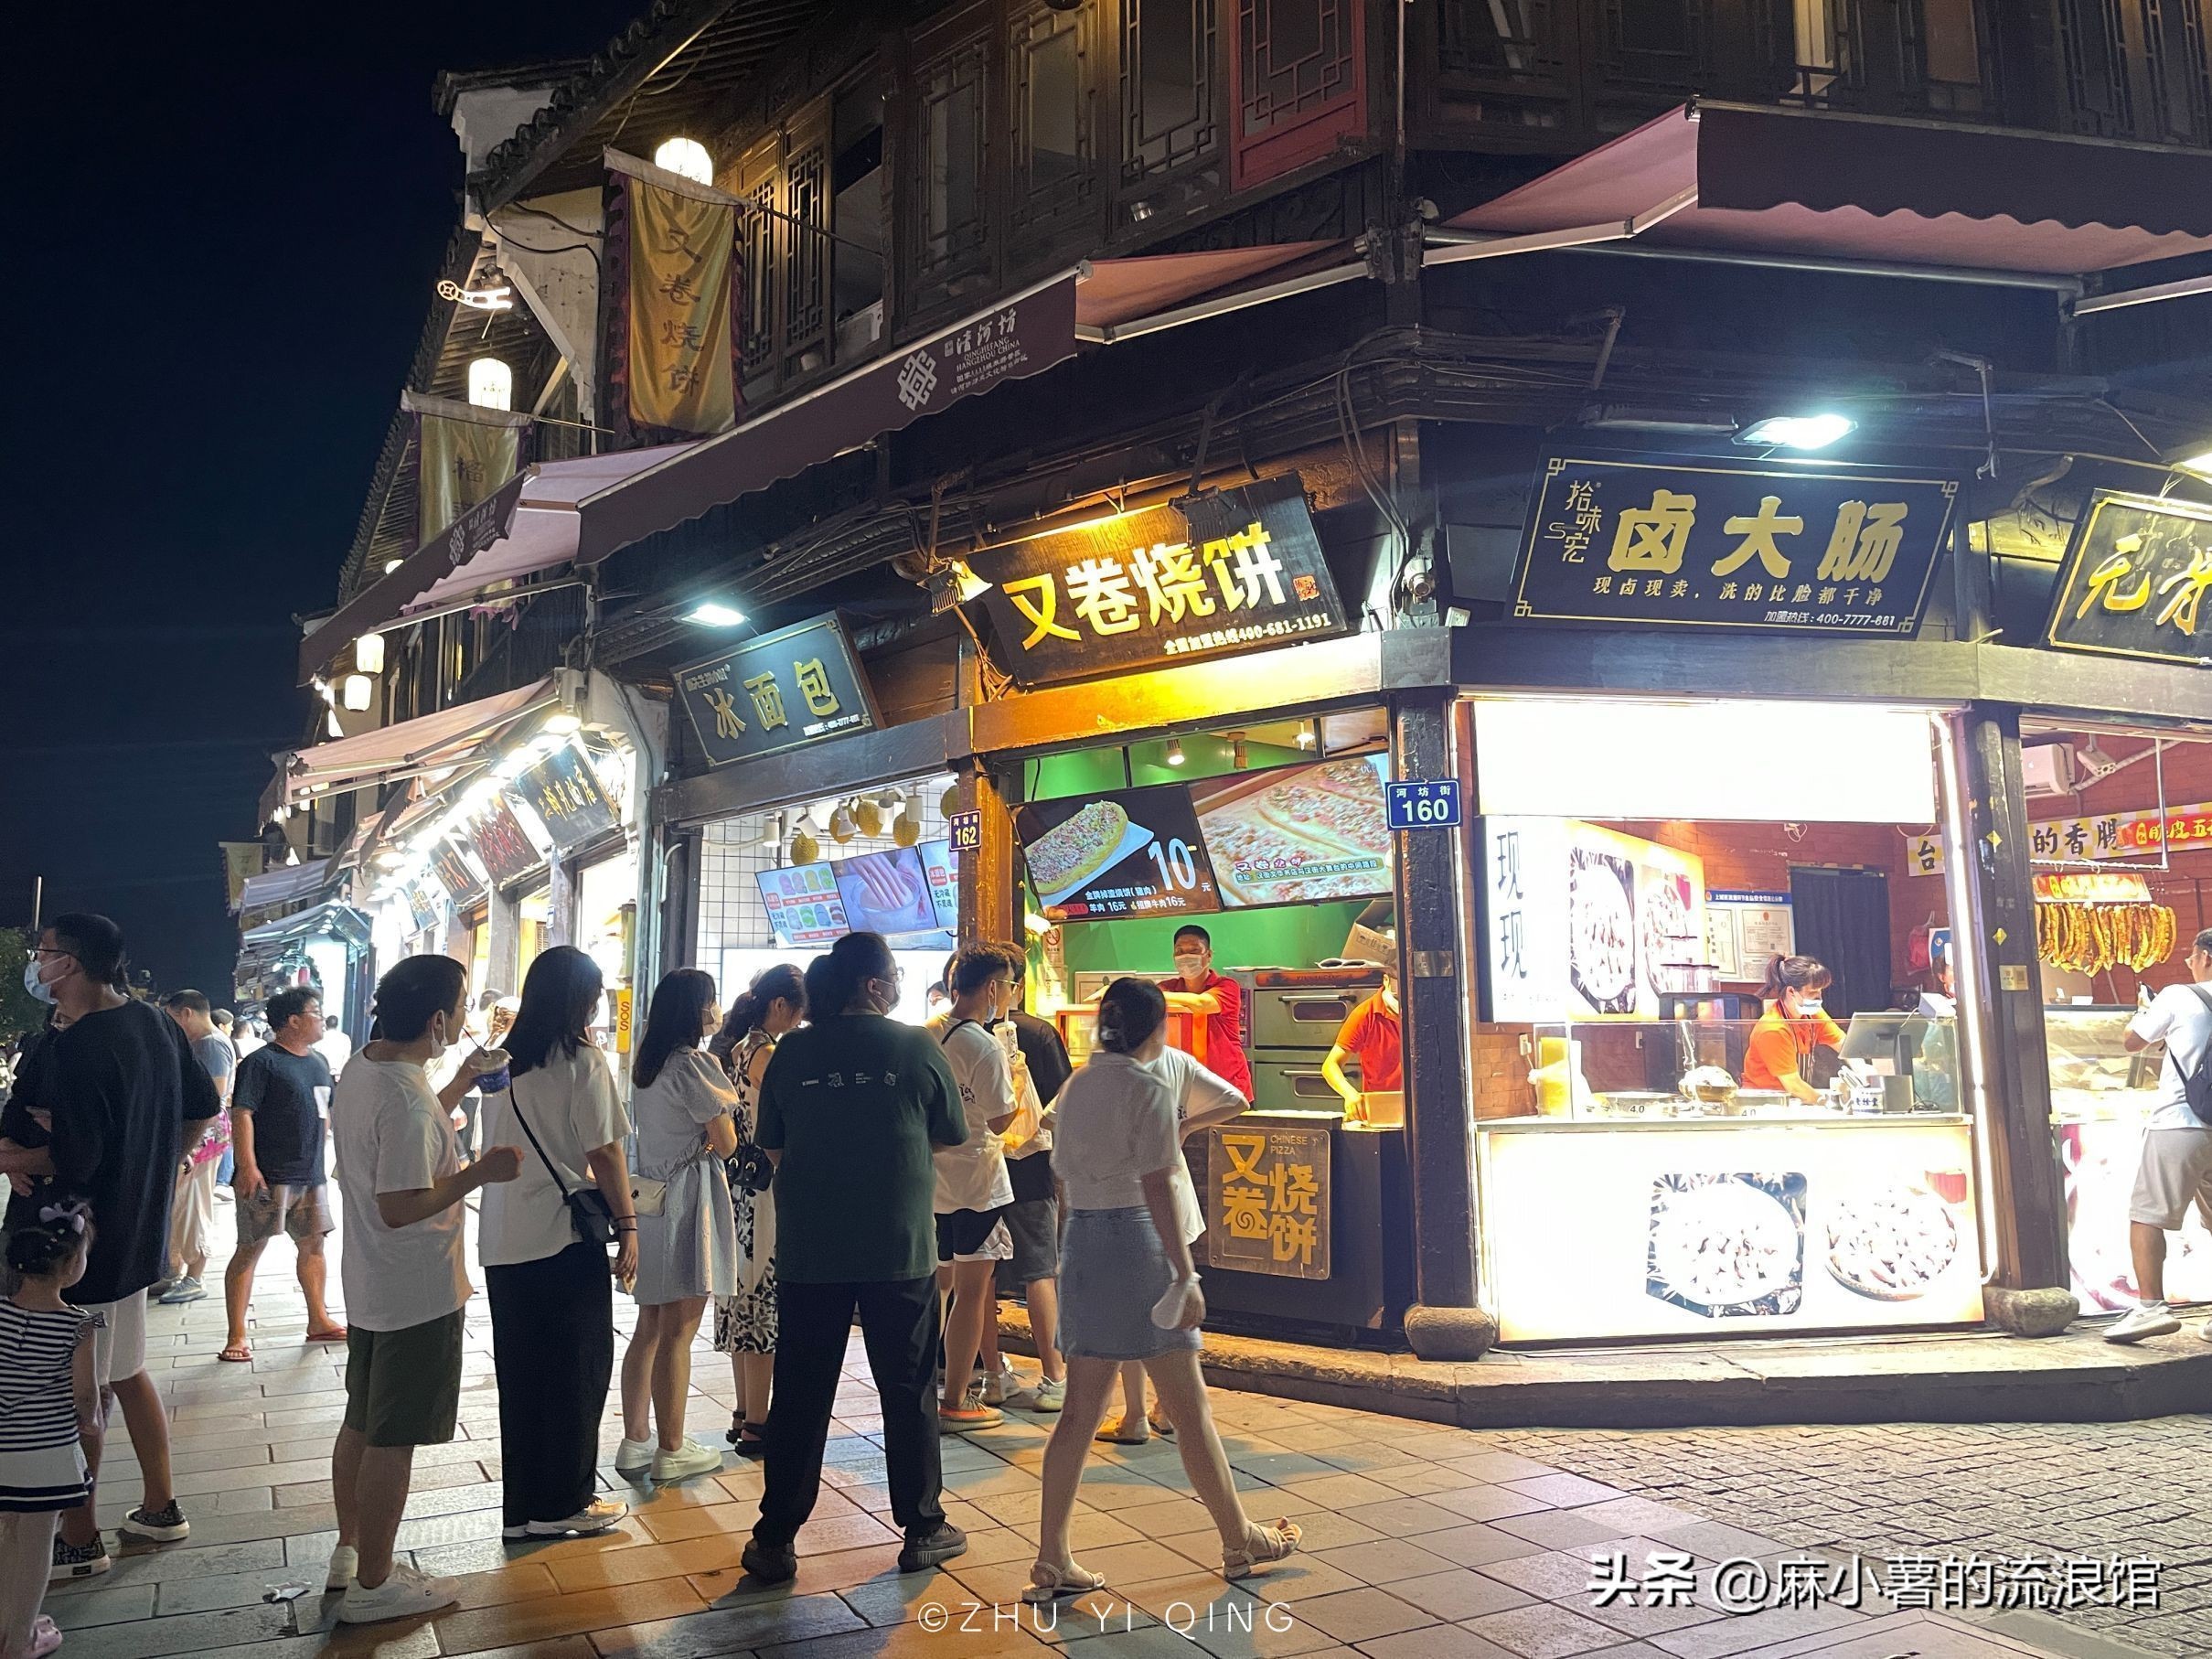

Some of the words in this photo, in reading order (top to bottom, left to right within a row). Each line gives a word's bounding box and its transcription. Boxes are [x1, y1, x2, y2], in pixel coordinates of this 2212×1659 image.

[658, 229, 705, 396] 又卷烧饼
[956, 349, 996, 371] HANGZHOU
[998, 339, 1021, 354] CHINA
[1607, 489, 1907, 583] 卤大肠
[1002, 521, 1287, 651] 又卷烧饼
[1396, 786, 1450, 798] 河坊街
[1403, 798, 1448, 822] 160
[956, 826, 976, 846] 162
[1149, 838, 1196, 891] 10
[1202, 883, 1211, 892] 元
[1918, 840, 1935, 871] 台
[620, 1001, 630, 1031] SOS
[1270, 1135, 1308, 1145] CHINESE
[1270, 1146, 1295, 1155] PIZZA
